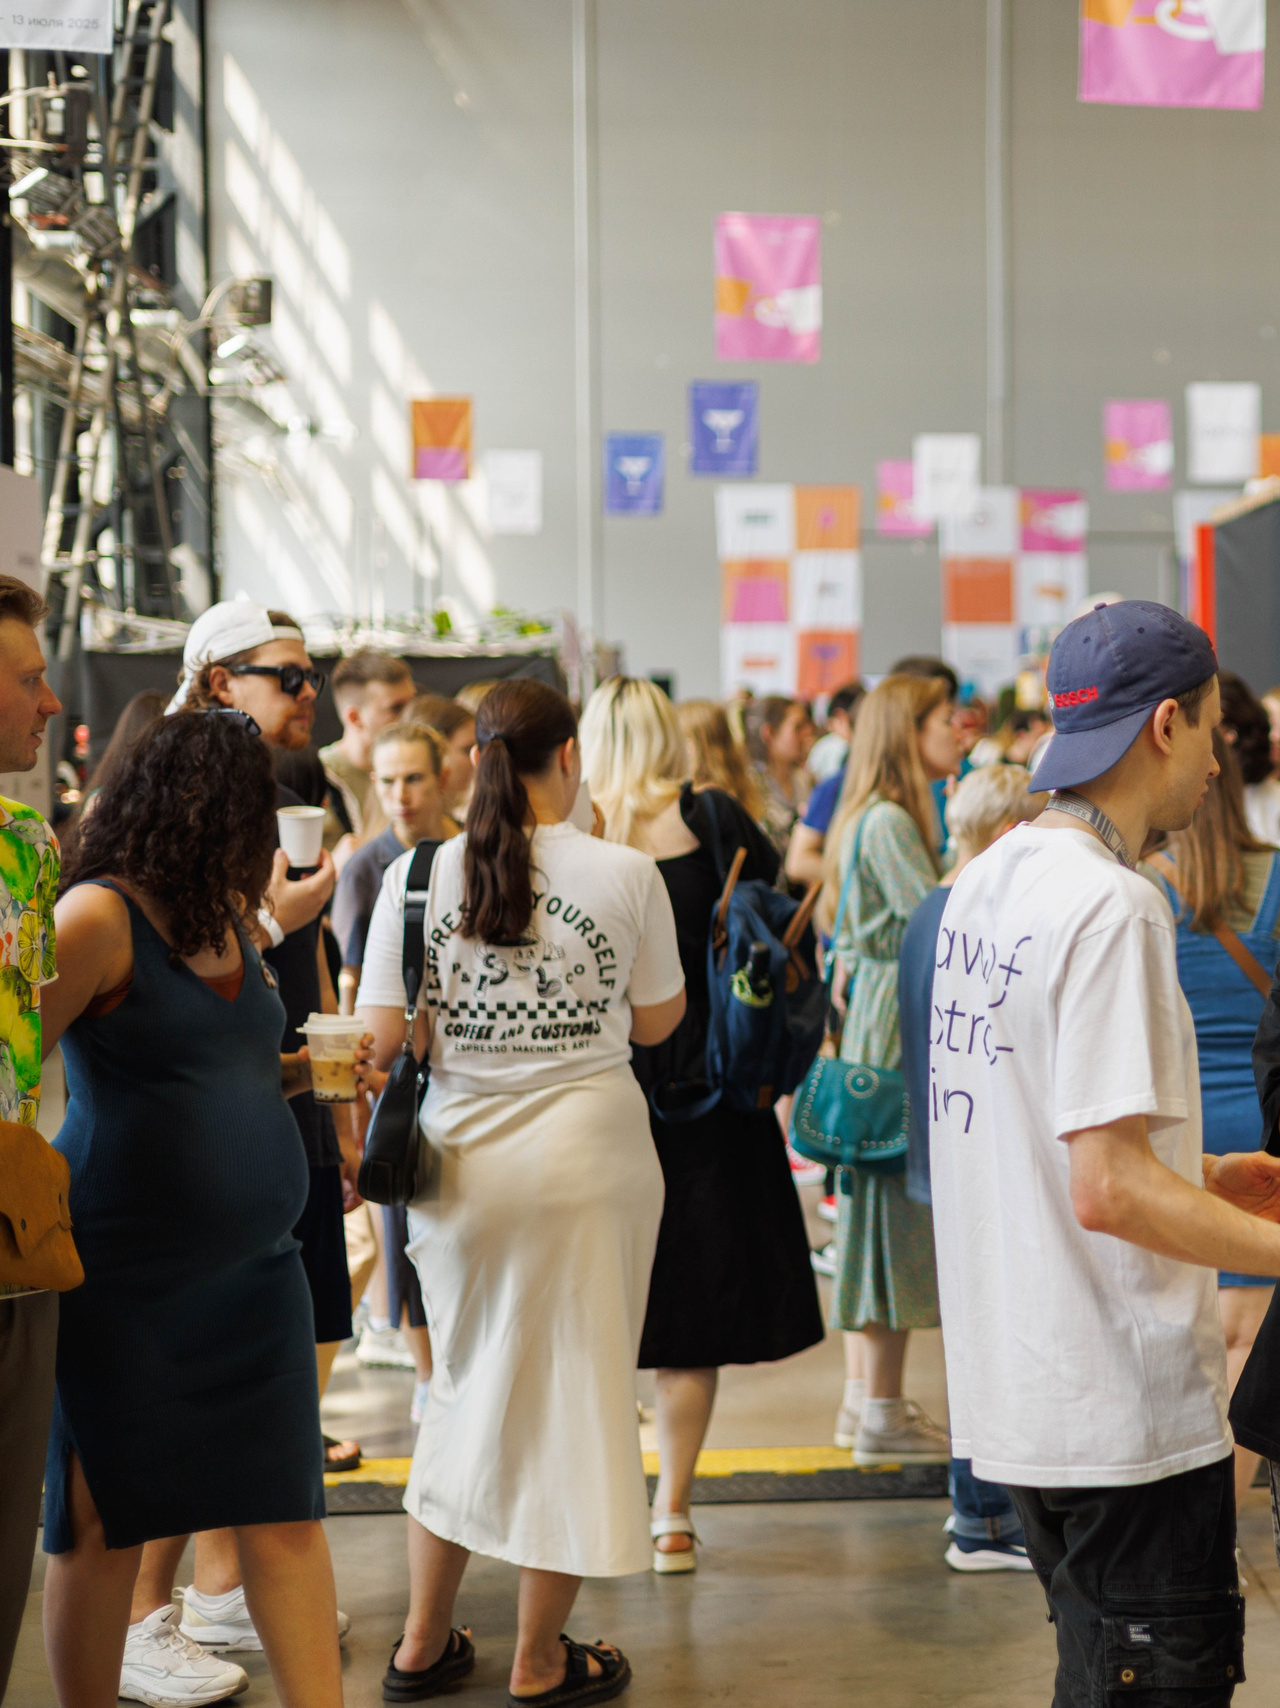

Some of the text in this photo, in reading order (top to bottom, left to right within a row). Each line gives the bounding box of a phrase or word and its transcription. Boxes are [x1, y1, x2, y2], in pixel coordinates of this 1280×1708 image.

[12, 15, 24, 25] 13
[28, 17, 63, 27] июля
[1054, 685, 1099, 709] BOSCH
[532, 891, 617, 991] YOURSELF
[444, 1023, 495, 1041] COFFEE
[530, 1018, 602, 1040] CUSTOMS
[454, 1039, 590, 1054] ESPRESSO MACHINES ART
